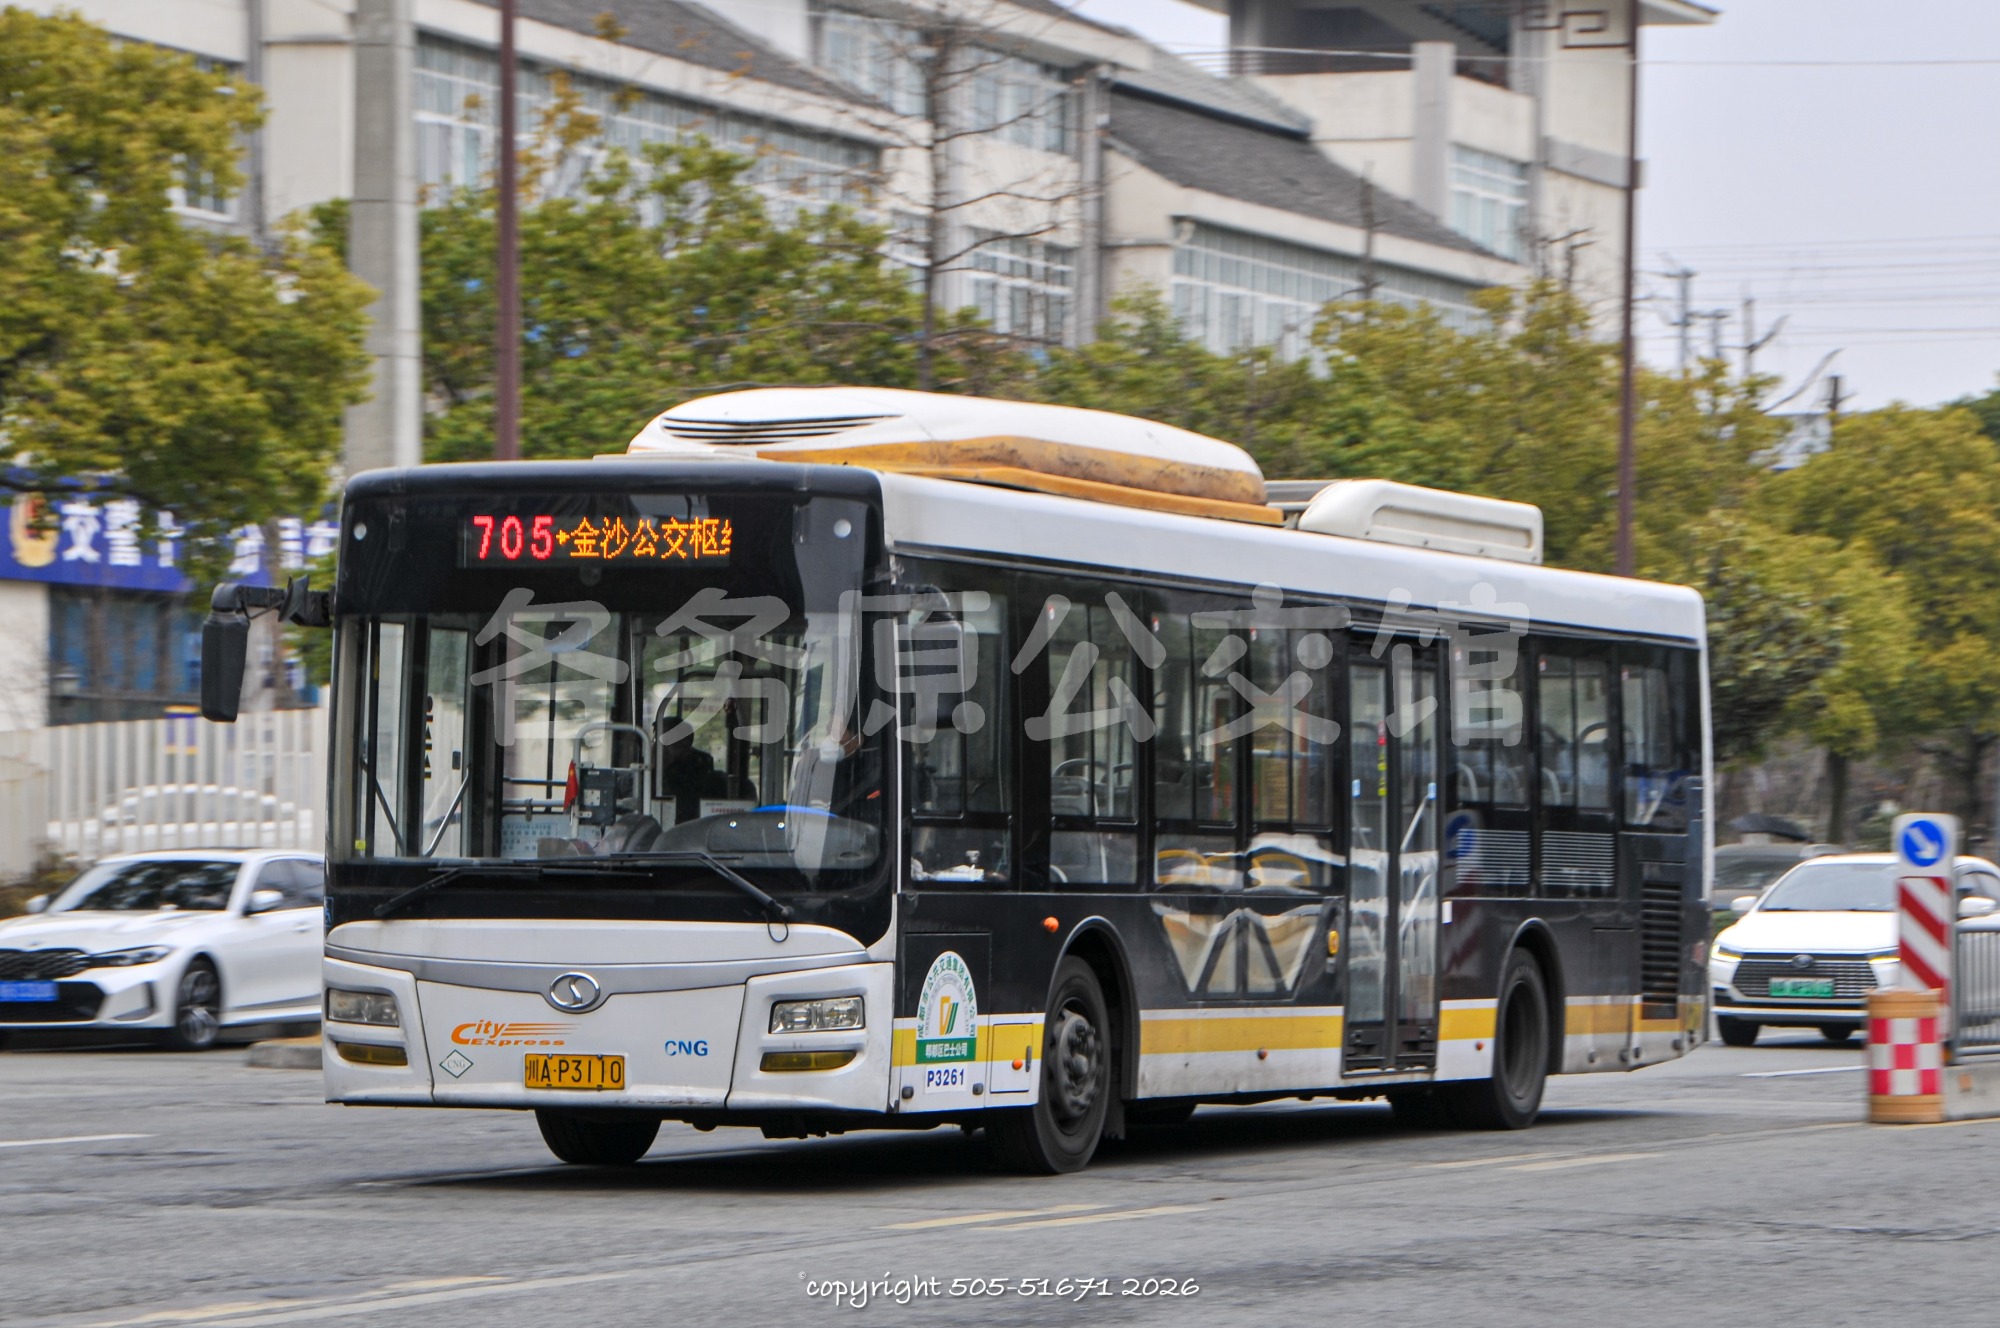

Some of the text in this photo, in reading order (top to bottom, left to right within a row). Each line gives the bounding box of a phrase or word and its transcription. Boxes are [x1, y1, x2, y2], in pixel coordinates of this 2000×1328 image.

[473, 516, 554, 560] 705
[450, 1019, 506, 1045] City
[470, 1037, 566, 1047] Express
[664, 1040, 709, 1057] CNG
[926, 1068, 965, 1088] P3261
